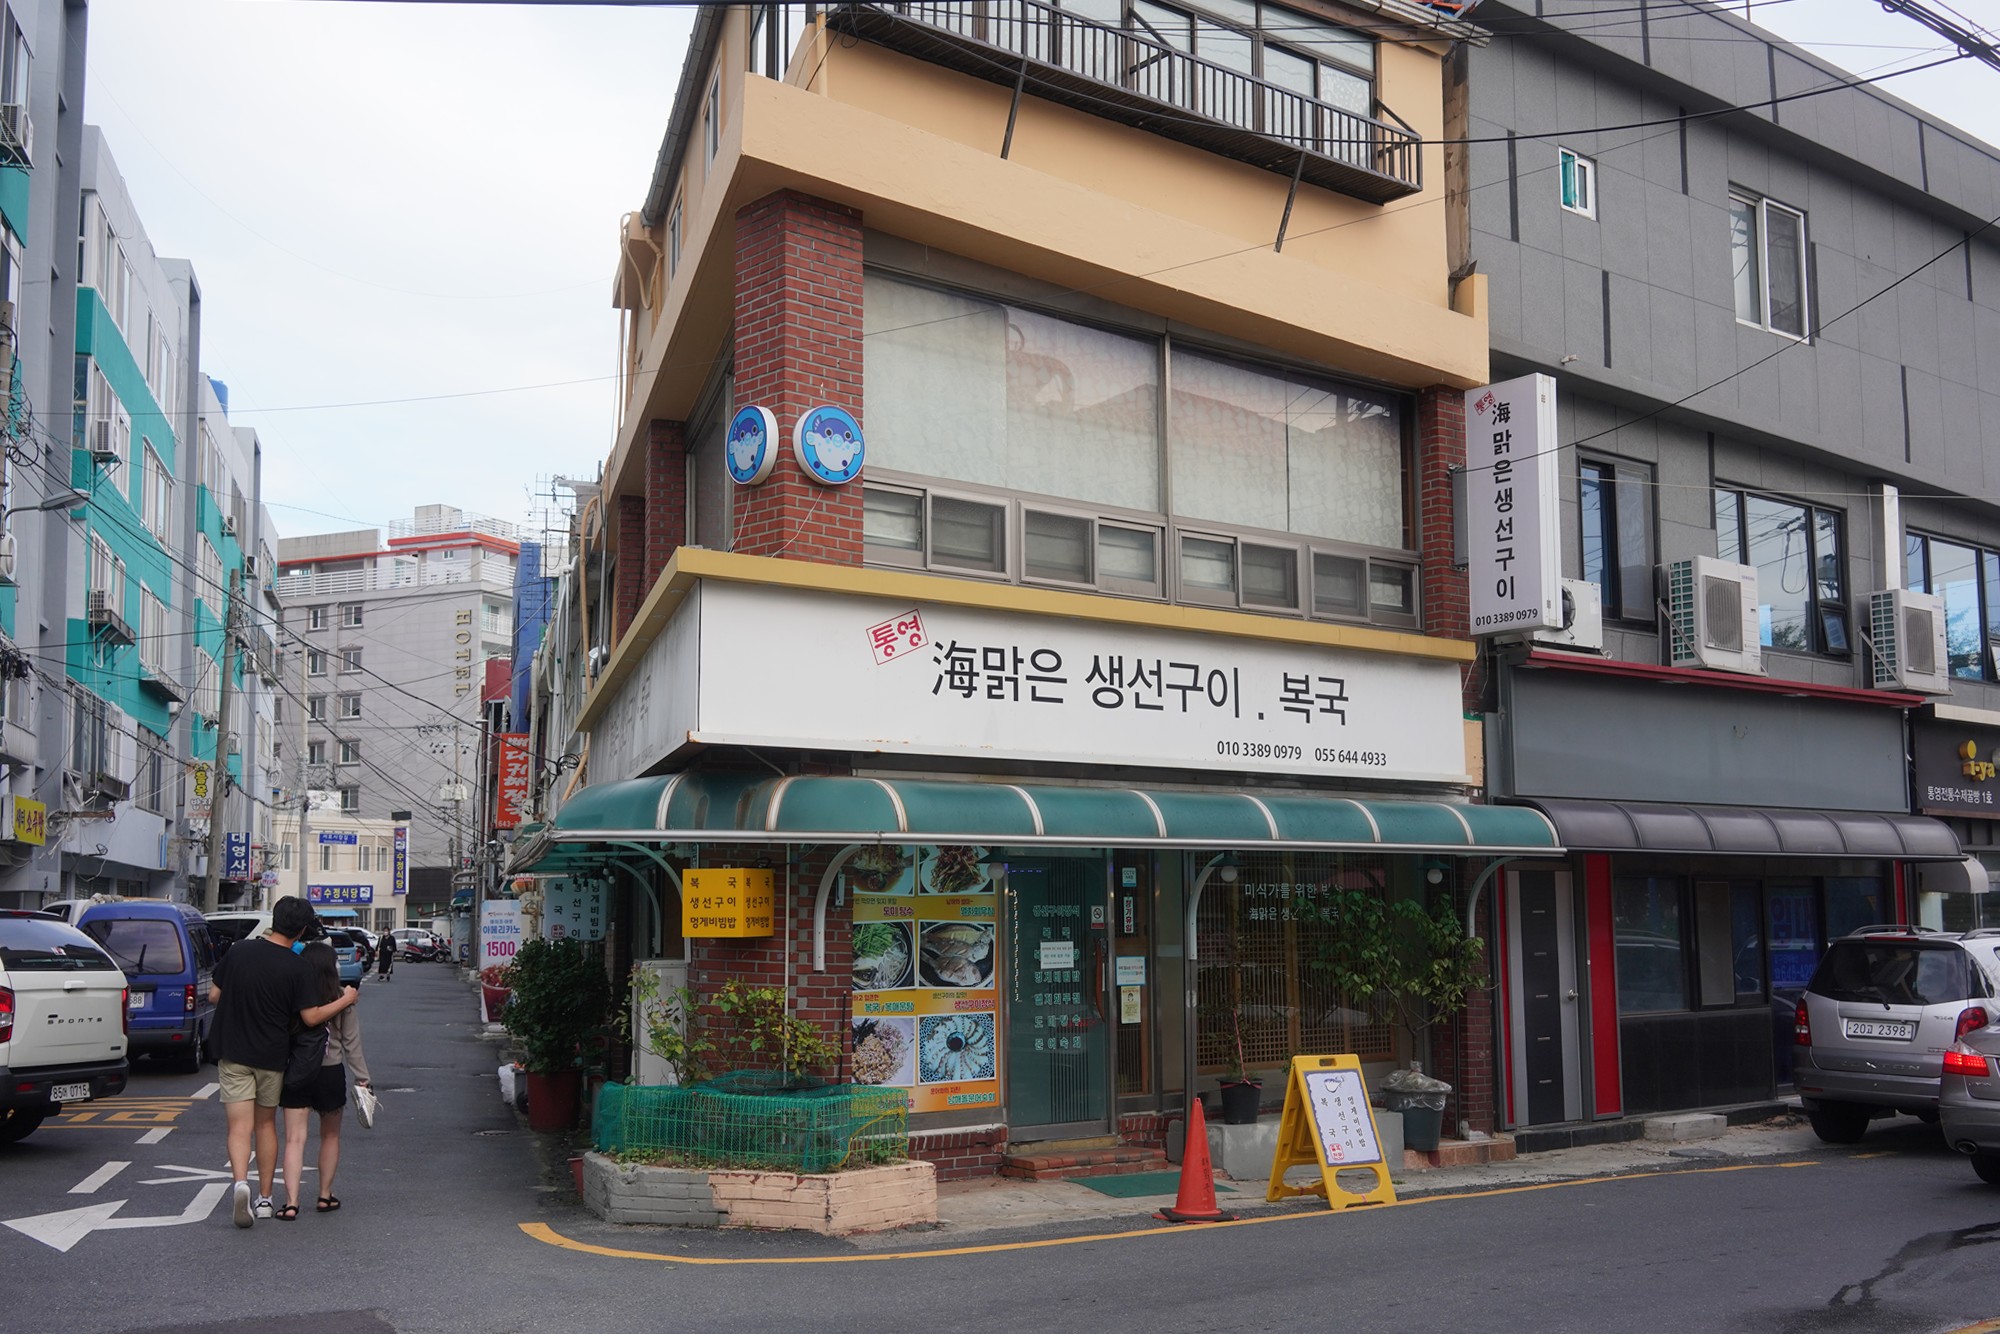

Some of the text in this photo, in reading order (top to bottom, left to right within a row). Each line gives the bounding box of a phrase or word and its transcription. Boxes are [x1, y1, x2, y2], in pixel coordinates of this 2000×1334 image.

[1475, 392, 1495, 415] 통영
[1476, 608, 1538, 627] 010 3389 0979
[871, 613, 923, 658] 통영
[455, 609, 472, 697] HOTEL
[932, 639, 1068, 704] 海맑은
[1085, 654, 1240, 719] 생선구이
[1279, 672, 1349, 726] 복국
[1217, 740, 1387, 767] 010 3389 0979 055 644 4933
[1982, 790, 1994, 804] 1호
[230, 833, 246, 871] 대영사
[396, 852, 404, 889] 수정식당
[324, 887, 358, 899] 수정식당
[1244, 883, 1291, 899] 미식가를
[1295, 883, 1318, 899] 위한
[690, 896, 736, 909] 생선구이
[746, 896, 770, 909] 생선구이
[883, 906, 899, 916] 도미
[1249, 907, 1278, 920] 海맑은
[690, 917, 736, 929] 멍게비빔밥
[746, 916, 770, 929] 멍게비빔밥
[482, 925, 520, 935] 아메리카노
[486, 941, 516, 957] 1500
[953, 999, 995, 1010] 생선구이정식
[47, 1017, 103, 1025] SPORTS
[1878, 1024, 1907, 1037] 2398
[70, 1084, 87, 1098] 0715
